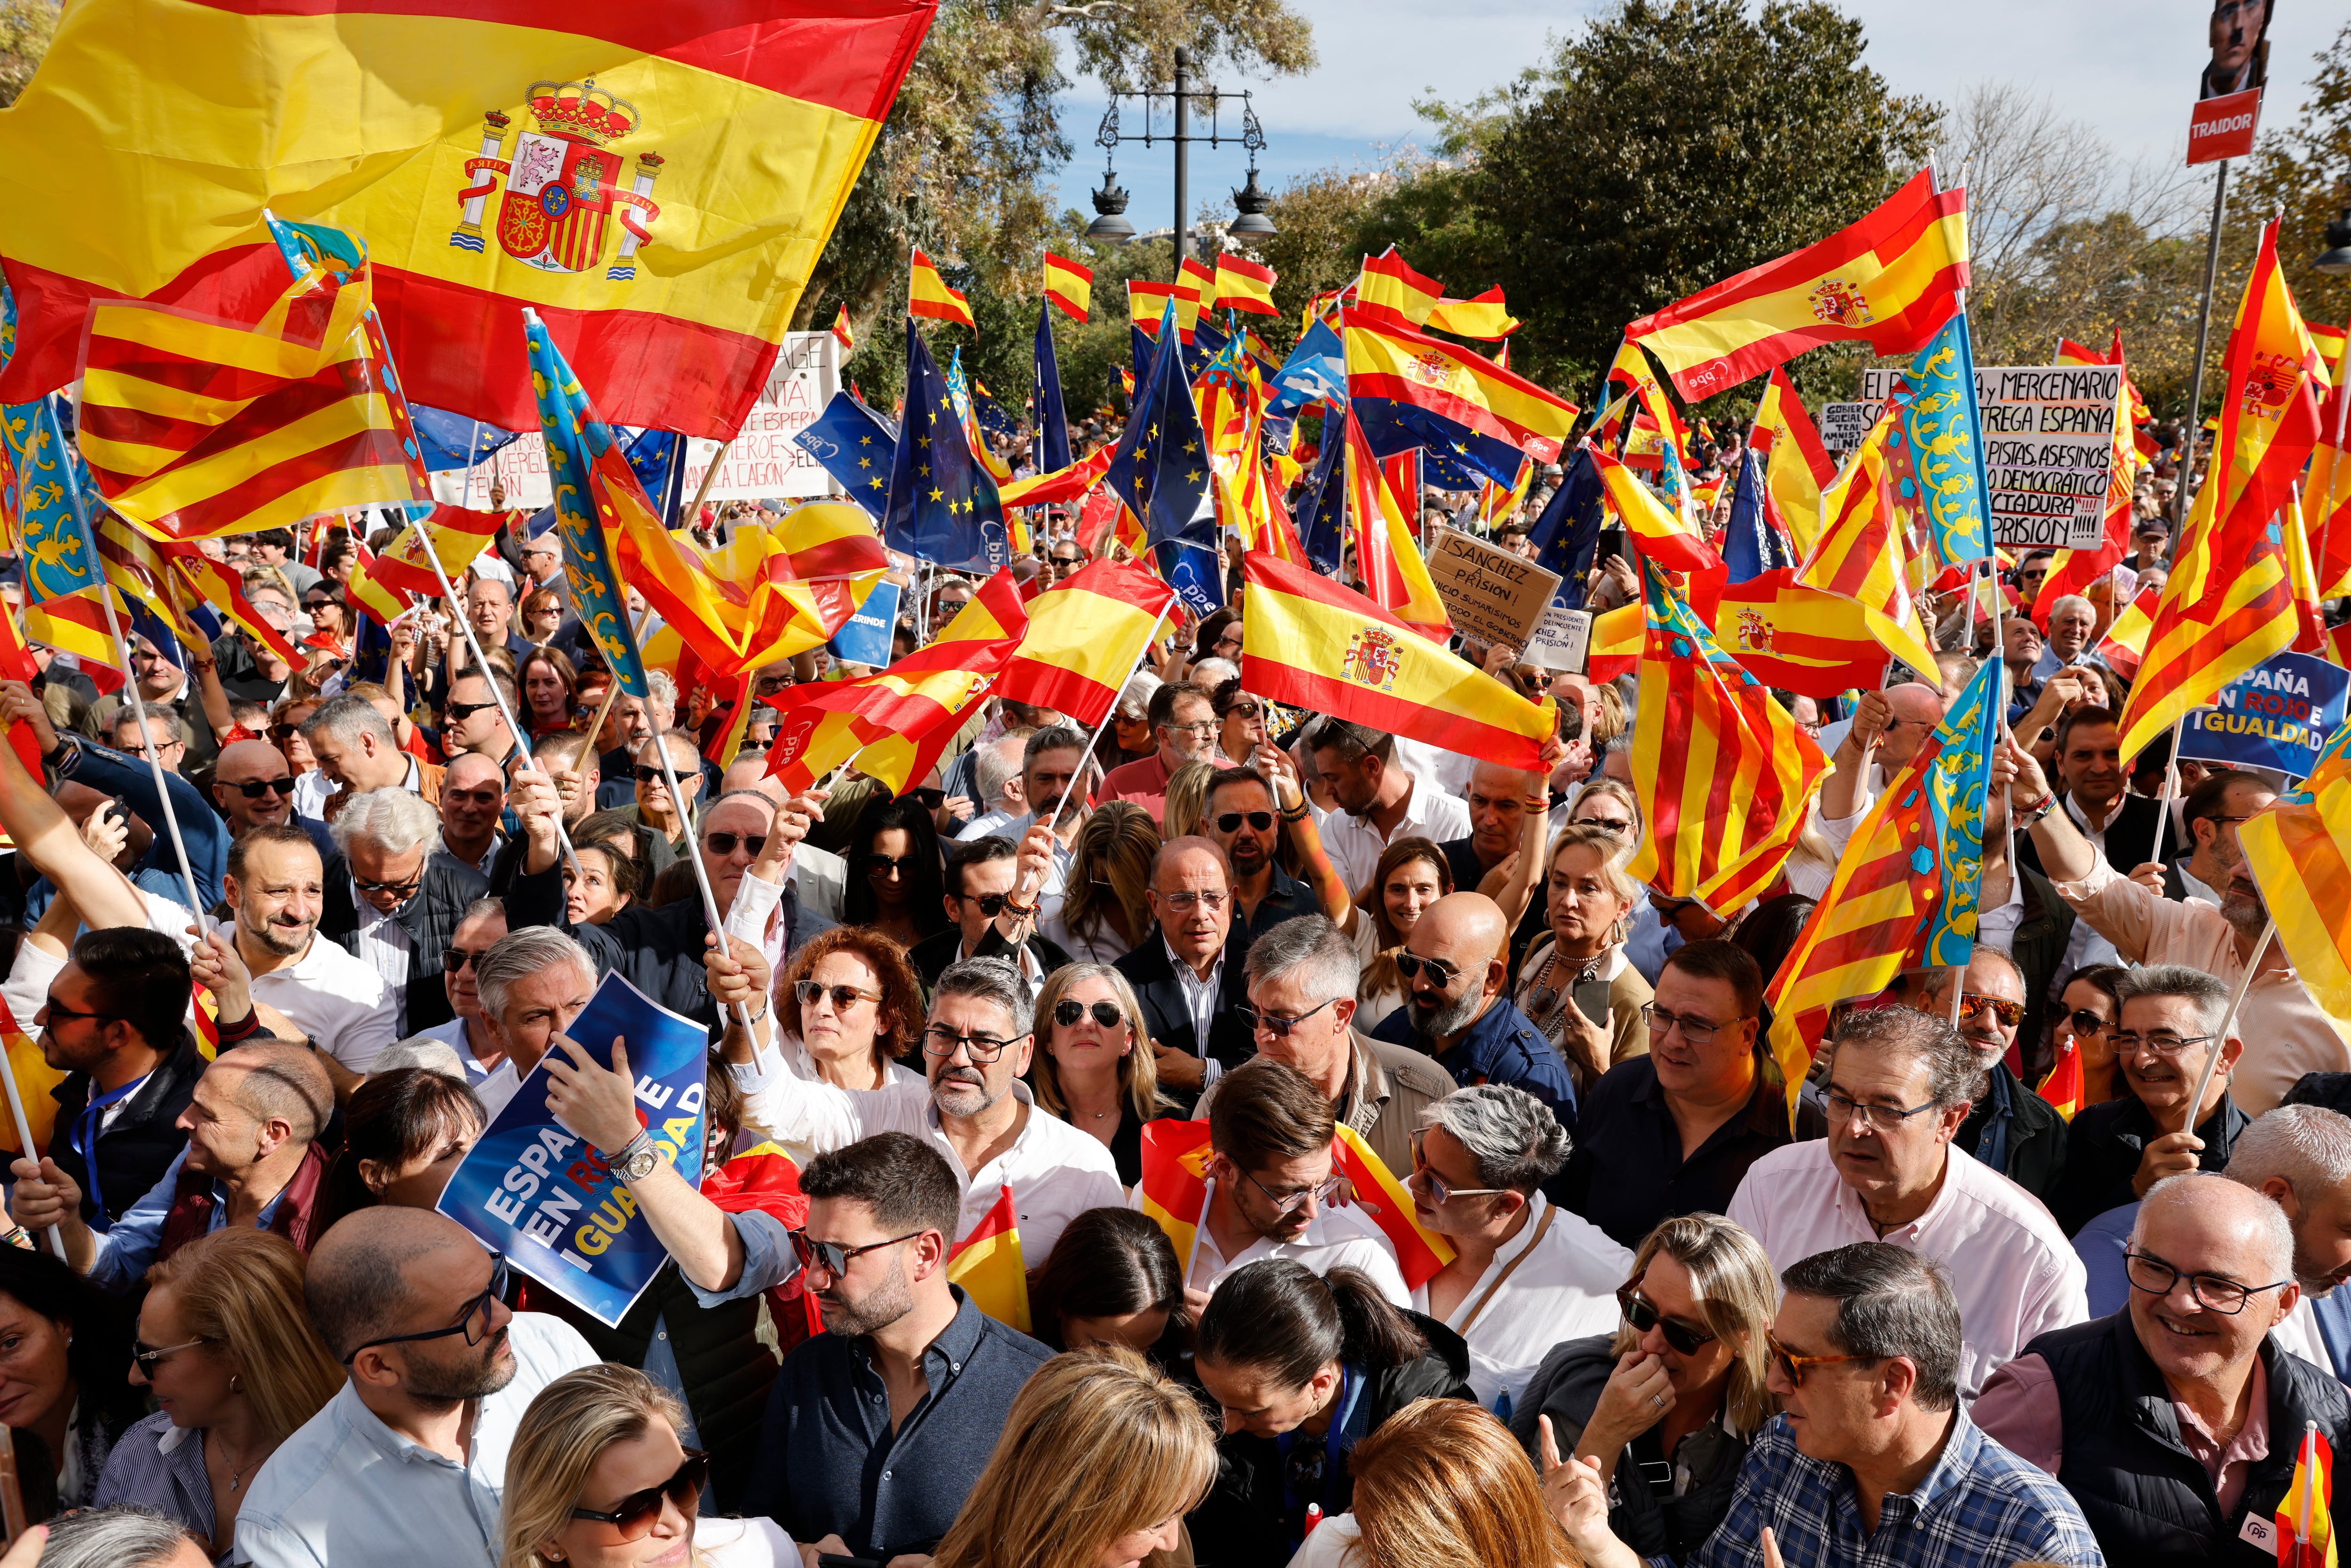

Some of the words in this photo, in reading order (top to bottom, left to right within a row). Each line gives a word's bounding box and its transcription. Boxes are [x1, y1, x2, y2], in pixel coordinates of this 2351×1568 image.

[2192, 113, 2253, 139] TRAIDOR
[1864, 372, 1883, 400] EL
[2000, 371, 2119, 401] MERCENARIO
[2040, 404, 2114, 433] ESPAÑA
[1531, 441, 1549, 452] ppe
[737, 460, 784, 487] CAGÓN
[1472, 567, 1482, 579] A
[1183, 584, 1216, 612] ppe
[1460, 594, 1522, 629] SUMARISIMOS
[1446, 602, 1471, 617] TODO
[1474, 615, 1483, 625] EL
[1554, 612, 1584, 624] PRESIDENTE
[1468, 632, 1482, 642] LOS
[2244, 691, 2309, 720] ROJO
[2309, 705, 2323, 727] E
[2193, 711, 2323, 752] IGUALDAD
[781, 736, 797, 764] ppe
[484, 1113, 582, 1225] ESPA
[522, 1185, 583, 1249] EN
[635, 1074, 674, 1111] E
[560, 1082, 704, 1273] IGUADAD
